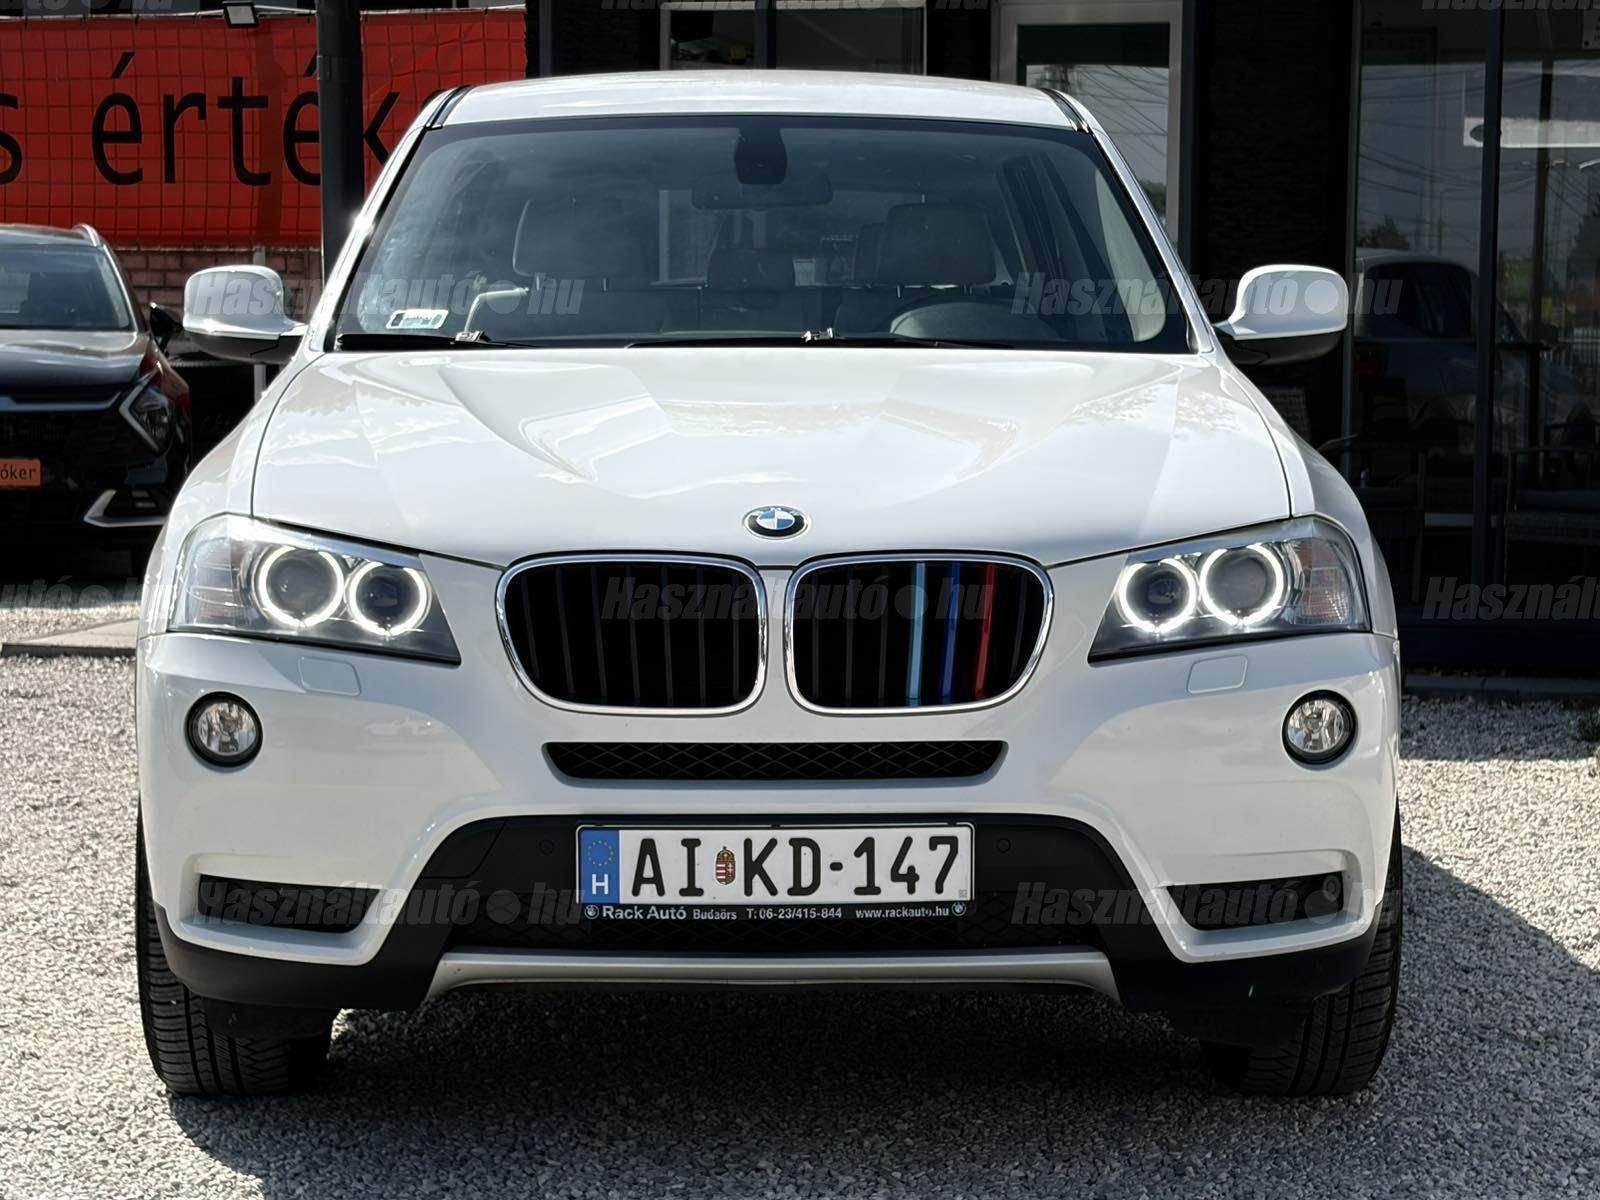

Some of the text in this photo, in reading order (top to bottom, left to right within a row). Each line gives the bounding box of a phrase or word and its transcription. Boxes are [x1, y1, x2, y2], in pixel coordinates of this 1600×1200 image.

[92, 51, 402, 186] érték
[591, 873, 609, 895] H
[631, 836, 960, 897] AI KD-147
[602, 905, 644, 920] Rack
[646, 904, 687, 920] Autó
[692, 907, 738, 920] Budaörs
[855, 905, 950, 919] www.rackauto.hu
